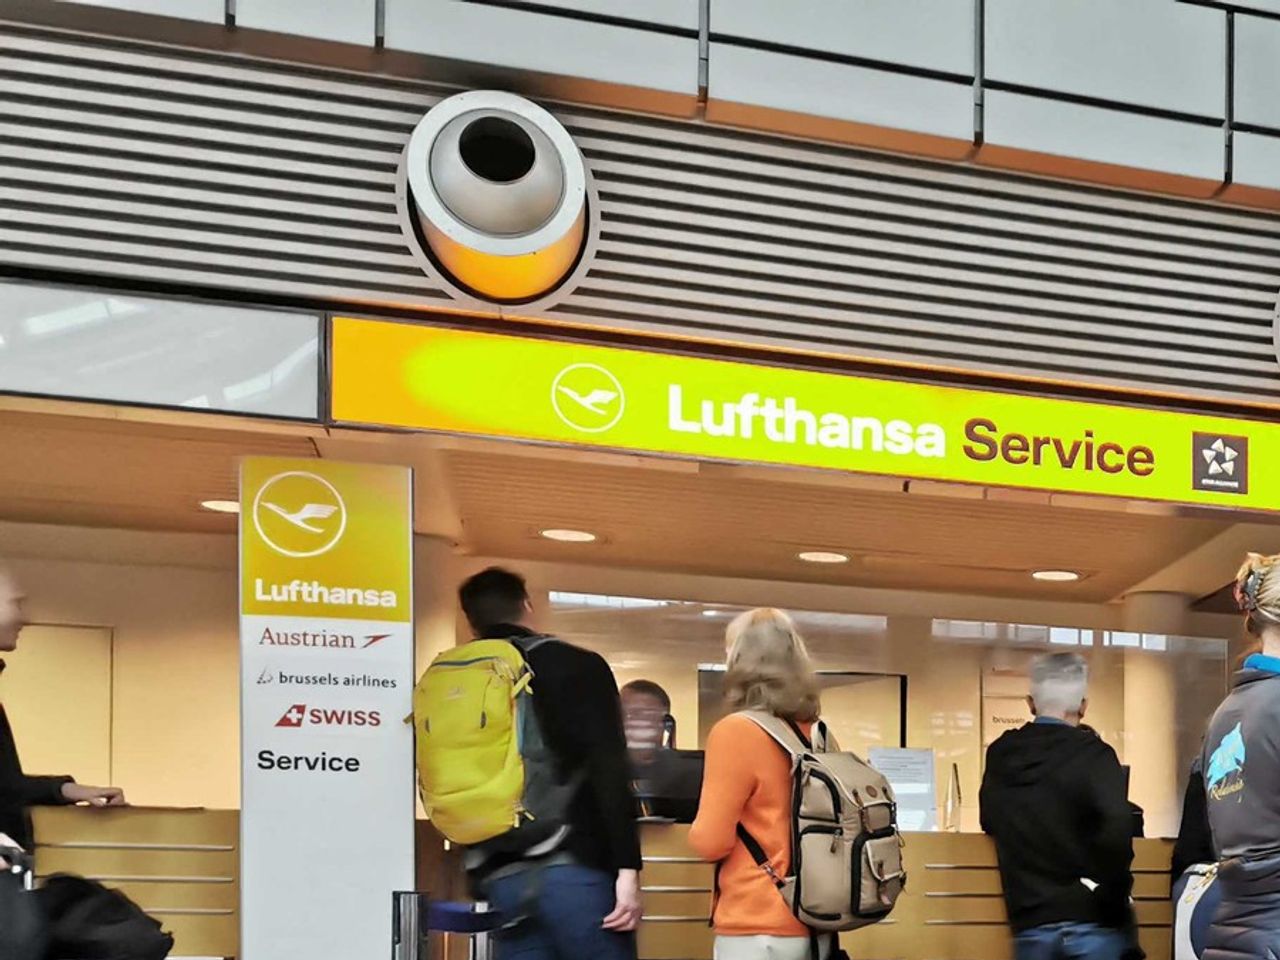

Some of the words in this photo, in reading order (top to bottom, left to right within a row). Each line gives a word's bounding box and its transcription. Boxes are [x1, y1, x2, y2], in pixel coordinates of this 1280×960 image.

[667, 384, 945, 458] Lufthansa
[963, 417, 1156, 476] Service
[255, 578, 397, 608] Lufthansa
[259, 627, 356, 649] Austrian
[279, 671, 339, 686] brussels
[342, 674, 397, 688] airlines
[309, 708, 381, 727] SWISS
[257, 749, 361, 772] Service
